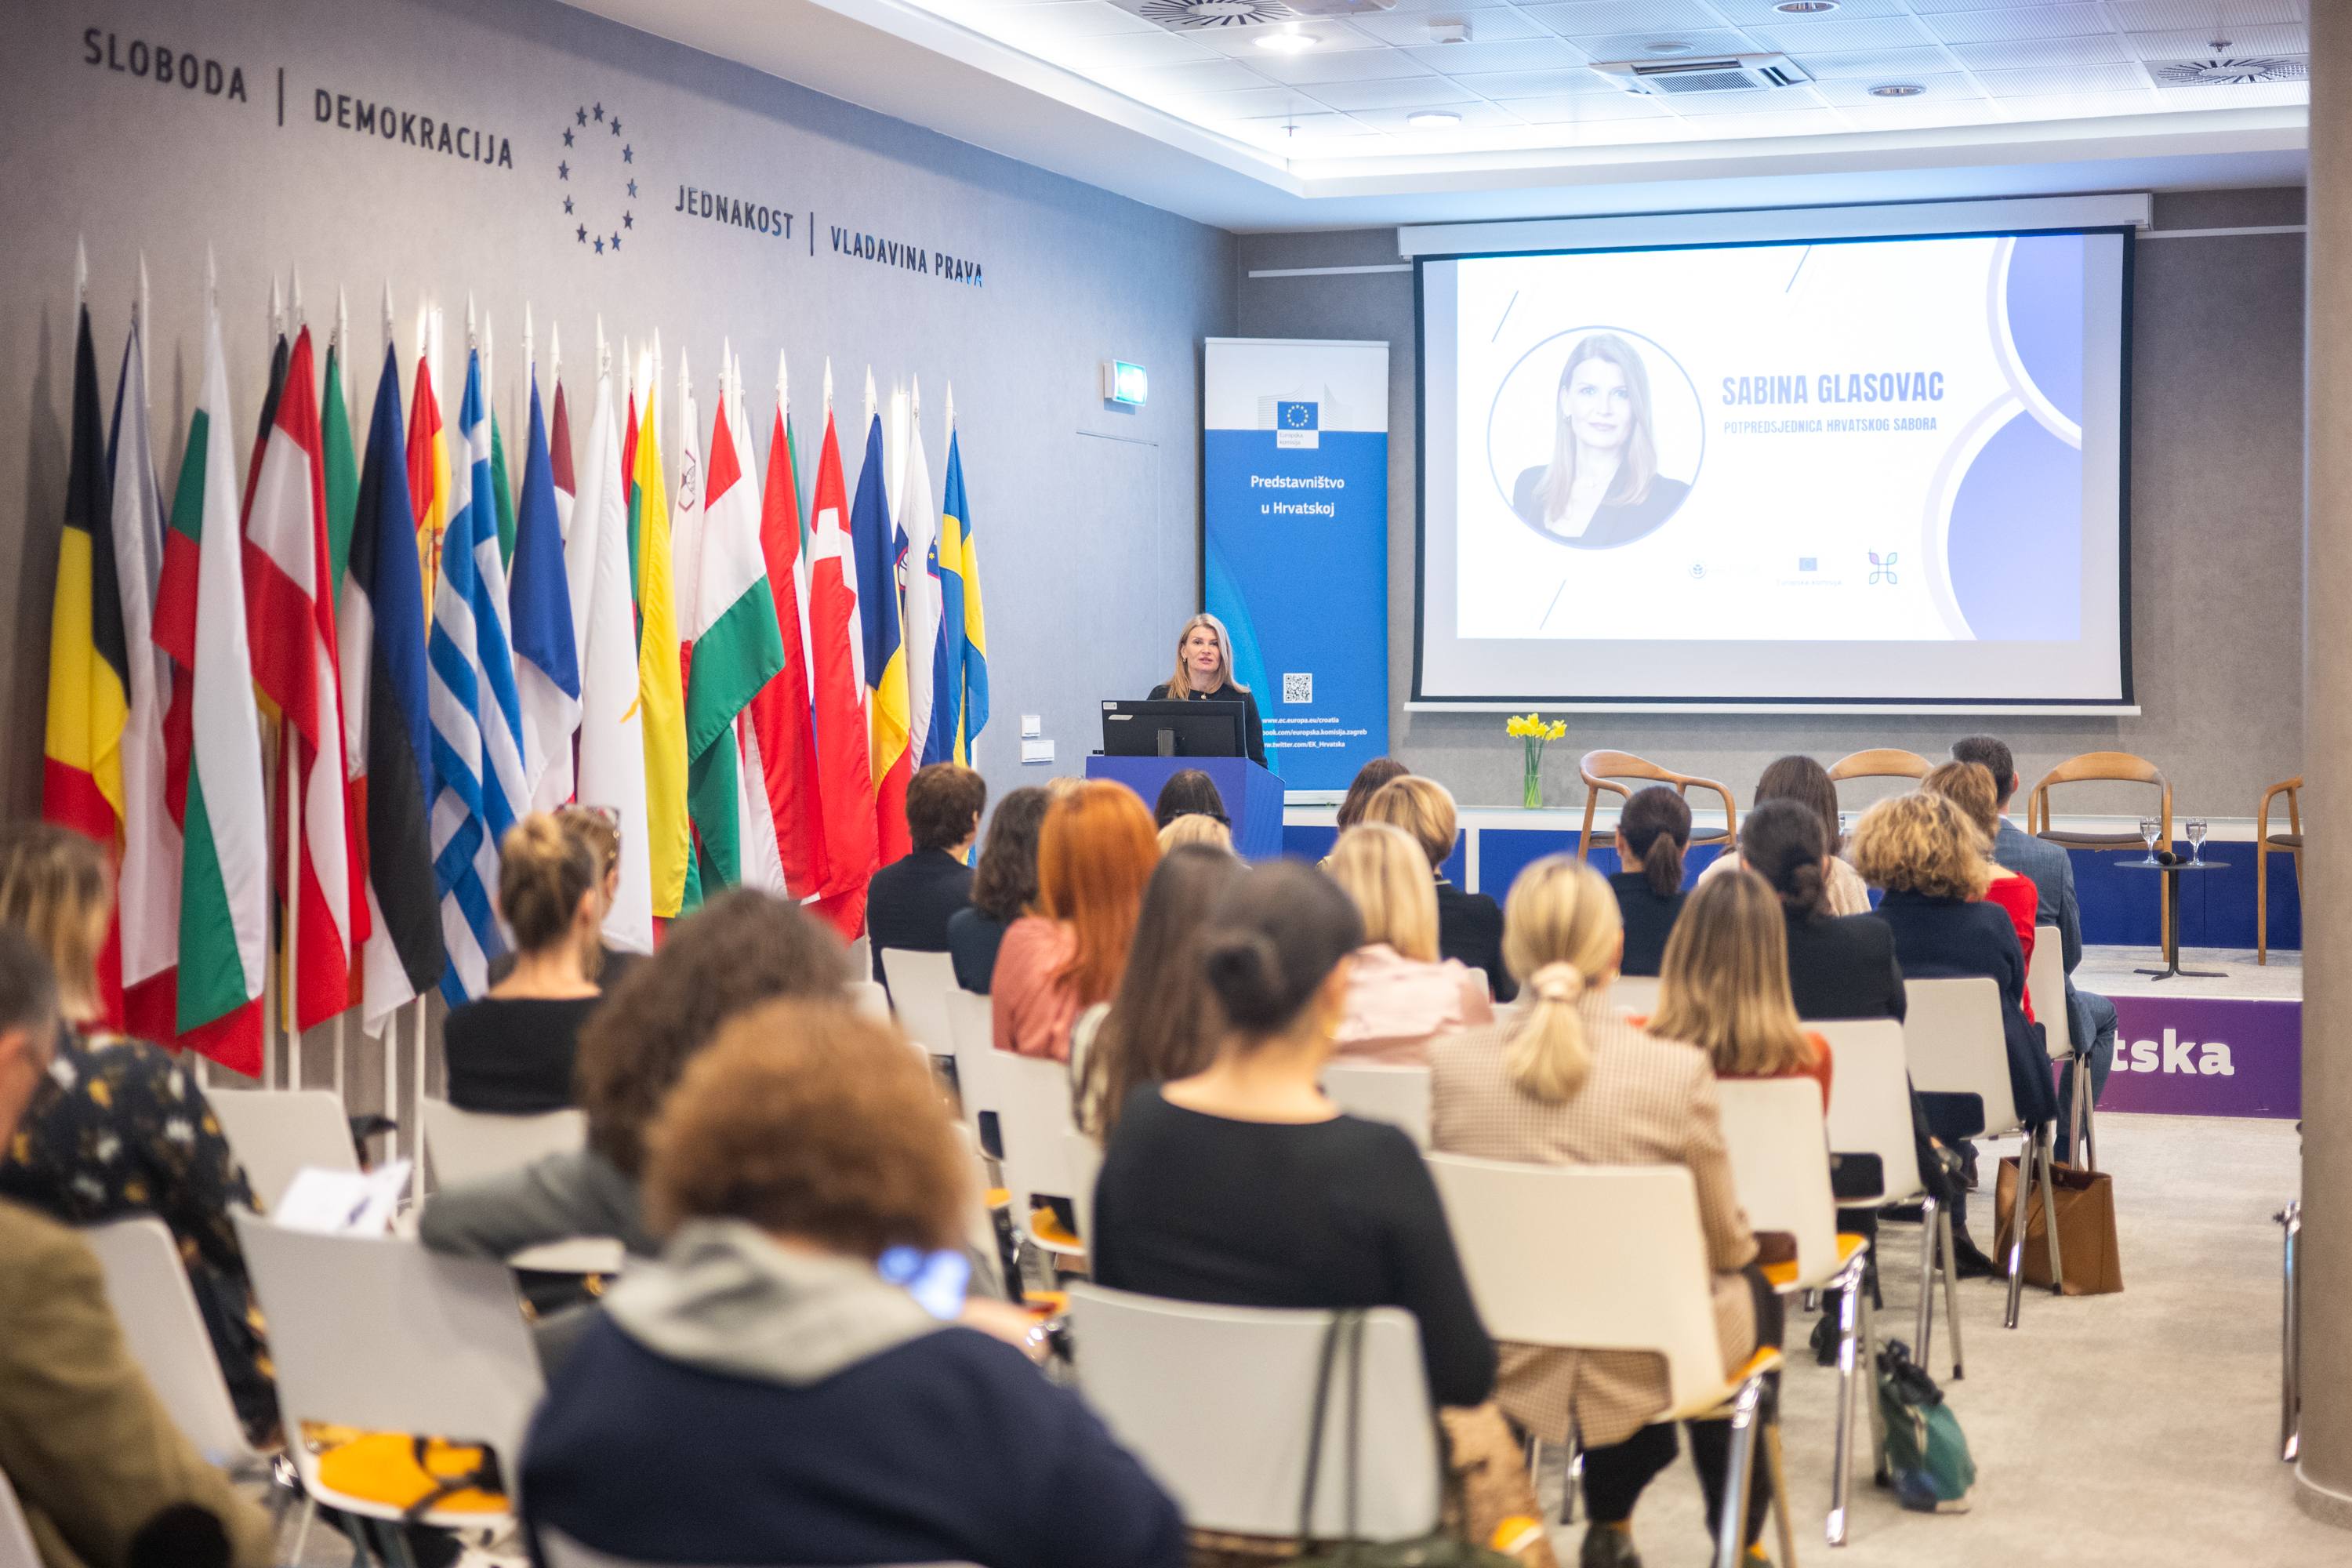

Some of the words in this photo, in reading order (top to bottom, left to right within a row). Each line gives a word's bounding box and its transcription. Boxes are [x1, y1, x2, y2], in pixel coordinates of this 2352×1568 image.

[83, 27, 247, 103] SLOBODA
[314, 88, 514, 169] DEMOKRACIJA
[675, 184, 793, 239] JEDNAKOST
[830, 225, 927, 274] VLADAVINA
[935, 252, 983, 288] PRAVA
[1722, 376, 1809, 405] SABINA
[1817, 371, 1944, 404] GLASOVAC
[1724, 419, 1823, 434] POTPREDSJEDNICA
[1826, 418, 1889, 432] HRVATSKOG
[1893, 417, 1937, 431] SABORA
[1250, 475, 1345, 488] Predstavništvo
[1261, 504, 1270, 514] u
[1273, 502, 1335, 517] Hrvatskoj
